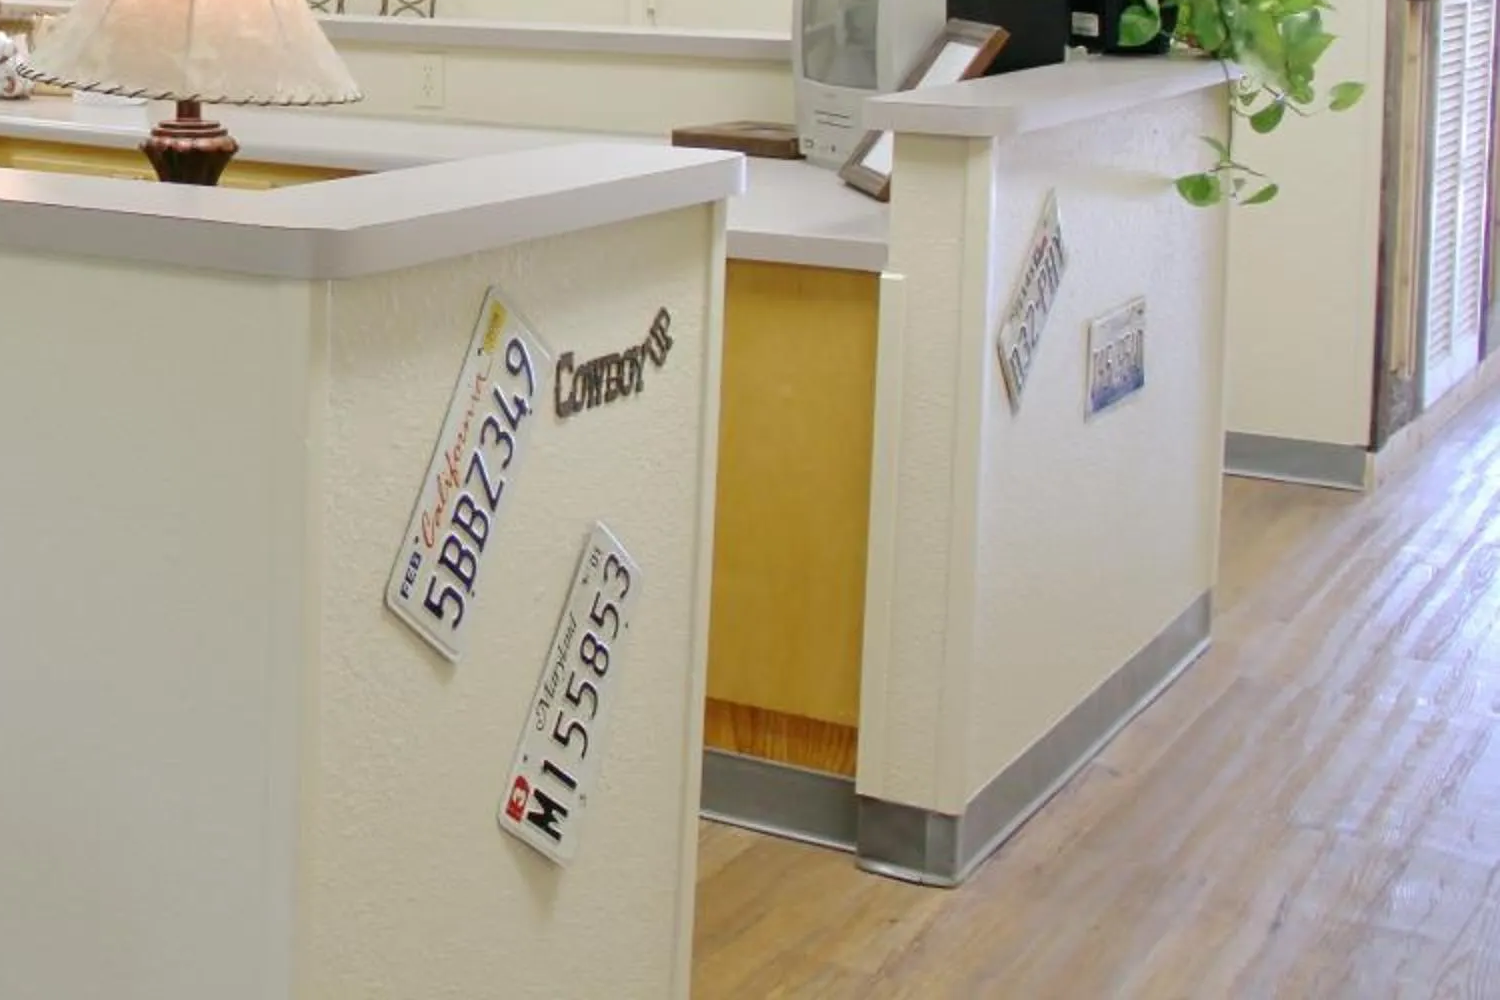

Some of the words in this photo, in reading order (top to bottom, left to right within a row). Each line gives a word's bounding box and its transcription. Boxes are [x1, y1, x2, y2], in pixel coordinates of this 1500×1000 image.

[400, 551, 423, 600] FEB
[421, 357, 493, 549] California
[424, 337, 537, 631] 5BBZ349
[528, 553, 632, 842] M155853
